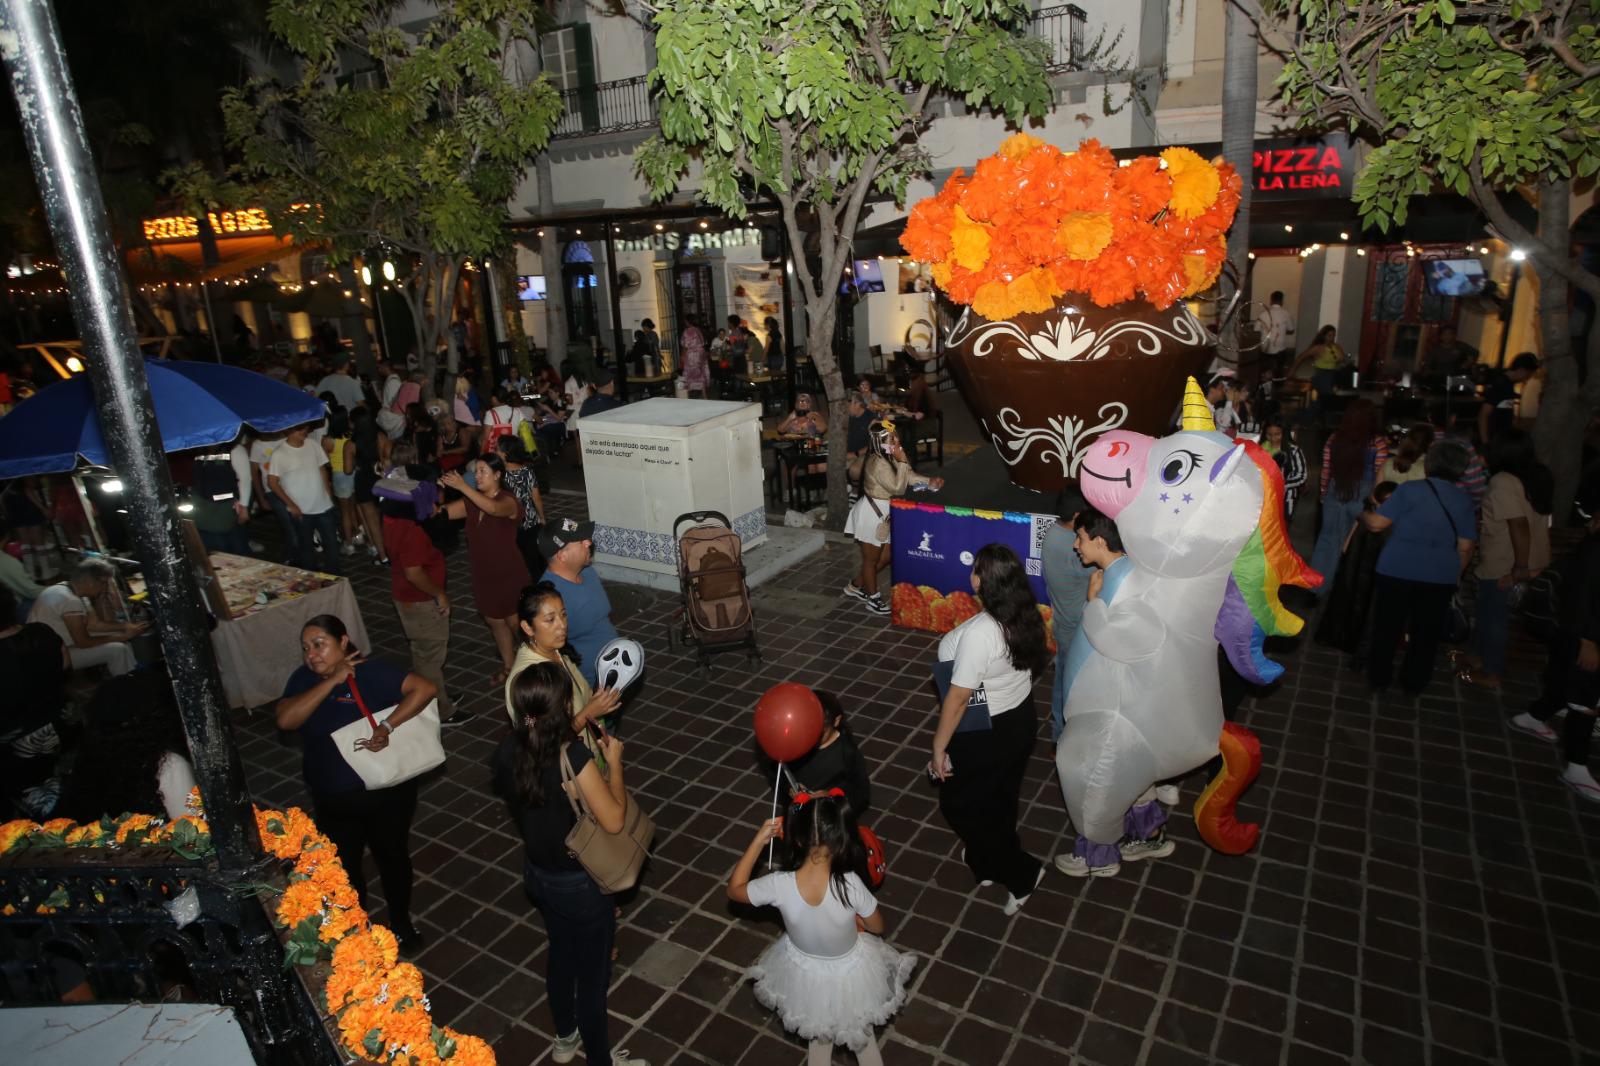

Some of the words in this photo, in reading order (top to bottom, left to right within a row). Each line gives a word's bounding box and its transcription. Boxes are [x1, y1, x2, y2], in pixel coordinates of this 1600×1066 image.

[1259, 176, 1284, 190] LA
[1288, 172, 1341, 189] LEÑA
[687, 227, 760, 250] ARMY
